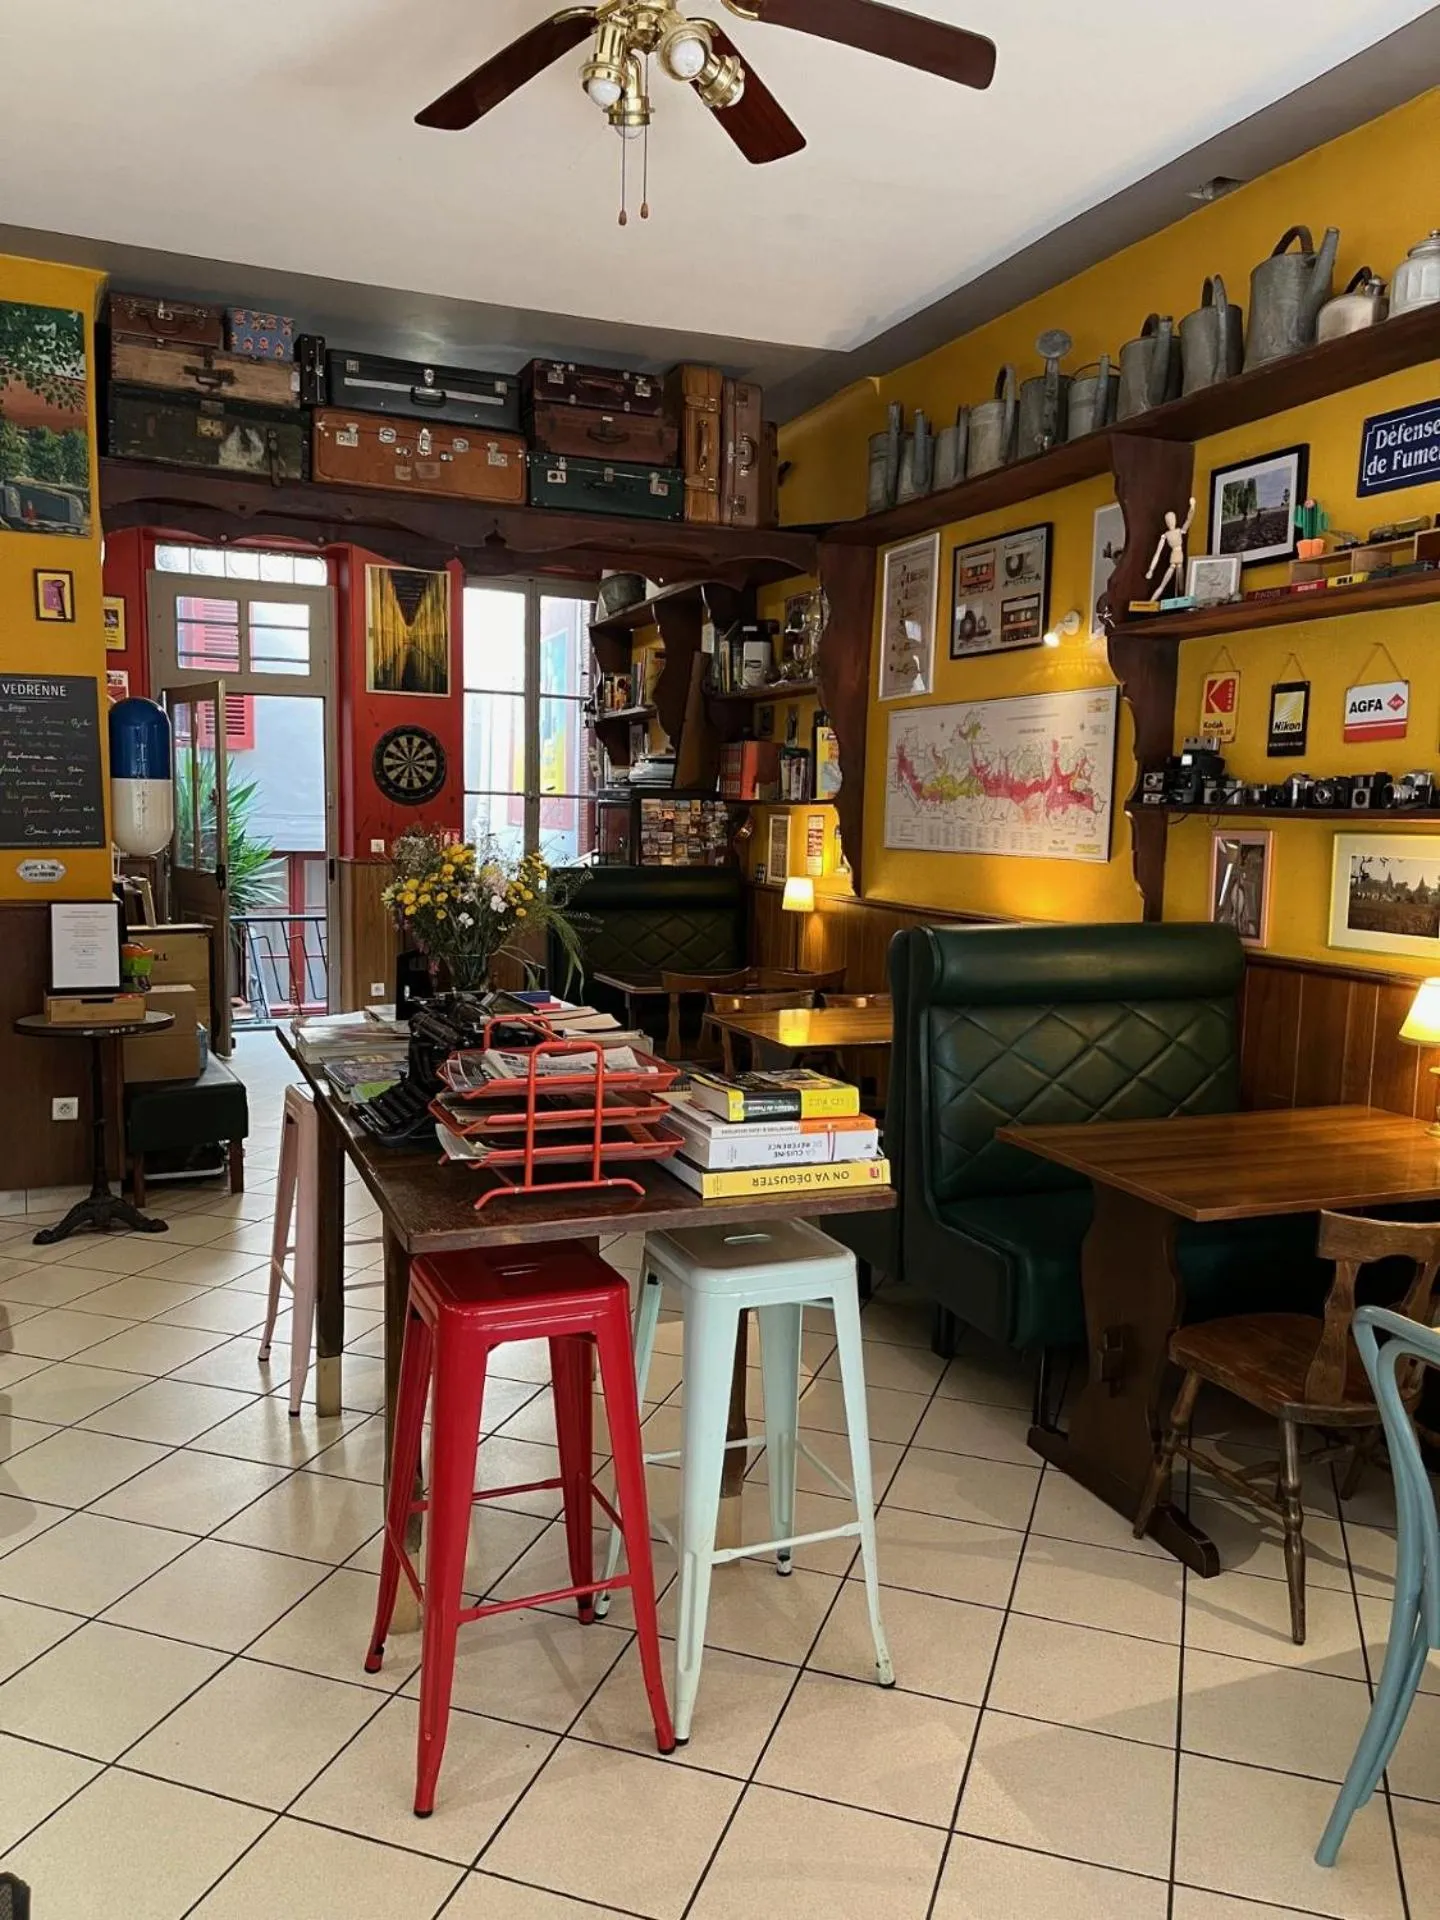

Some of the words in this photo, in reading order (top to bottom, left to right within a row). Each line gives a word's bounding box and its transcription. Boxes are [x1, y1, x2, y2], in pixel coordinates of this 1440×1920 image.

[1375, 418, 1440, 450] Défense
[1366, 455, 1387, 476] de
[1392, 445, 1440, 470] Fume
[2, 683, 67, 697] VEDRENNE
[1349, 698, 1383, 714] AGFA
[1203, 720, 1224, 729] Kodak
[1274, 721, 1302, 731] Nikon
[773, 1149, 804, 1158] CUISINE
[752, 1173, 811, 1187] DÉGUSTER
[814, 1172, 830, 1183] VA
[832, 1170, 850, 1181] ON
